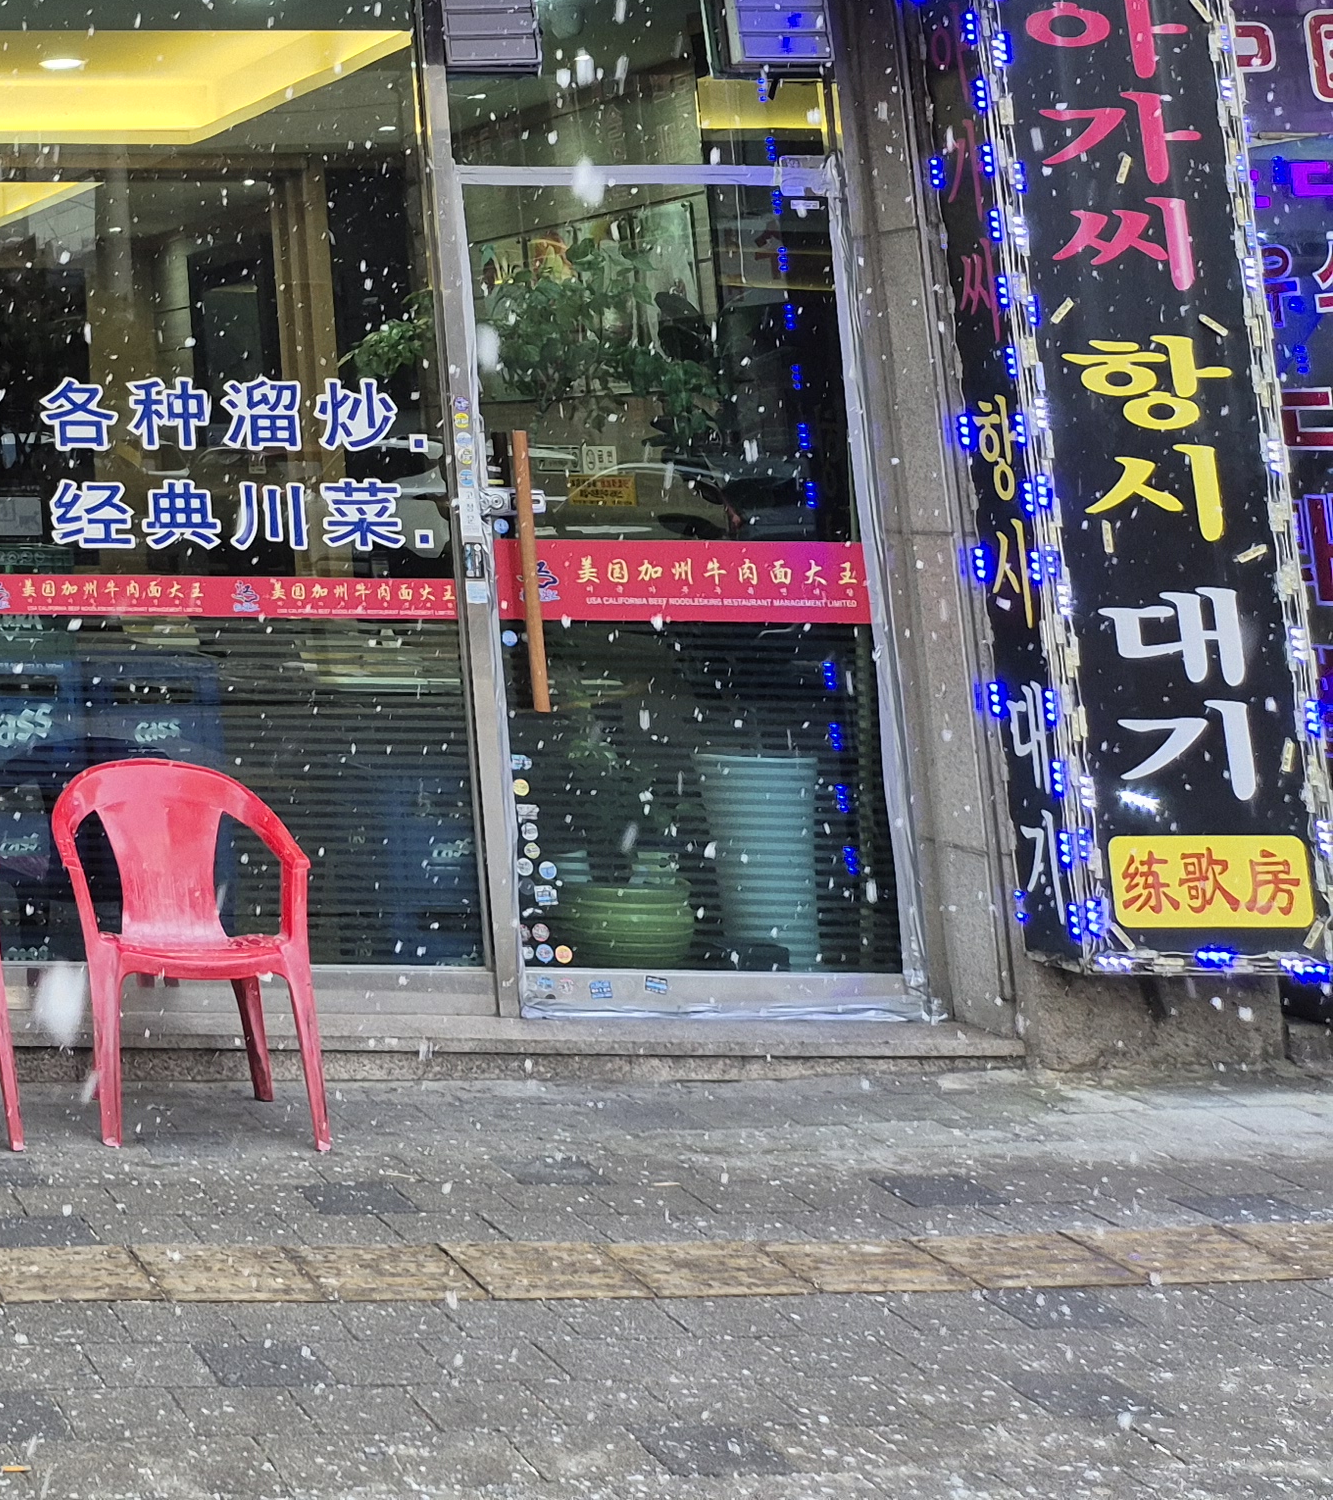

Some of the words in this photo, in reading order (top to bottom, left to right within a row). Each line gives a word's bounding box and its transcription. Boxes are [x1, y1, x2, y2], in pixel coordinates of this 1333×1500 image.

[1059, 334, 1233, 543] 항시
[21, 578, 205, 599] 美国加州牛肉面大王
[270, 581, 457, 602] 美国加州牛肉面大王
[576, 556, 860, 587] 美国加州牛肉面大王
[1097, 585, 1258, 802] 대기
[1121, 847, 1301, 917] 练歌房
